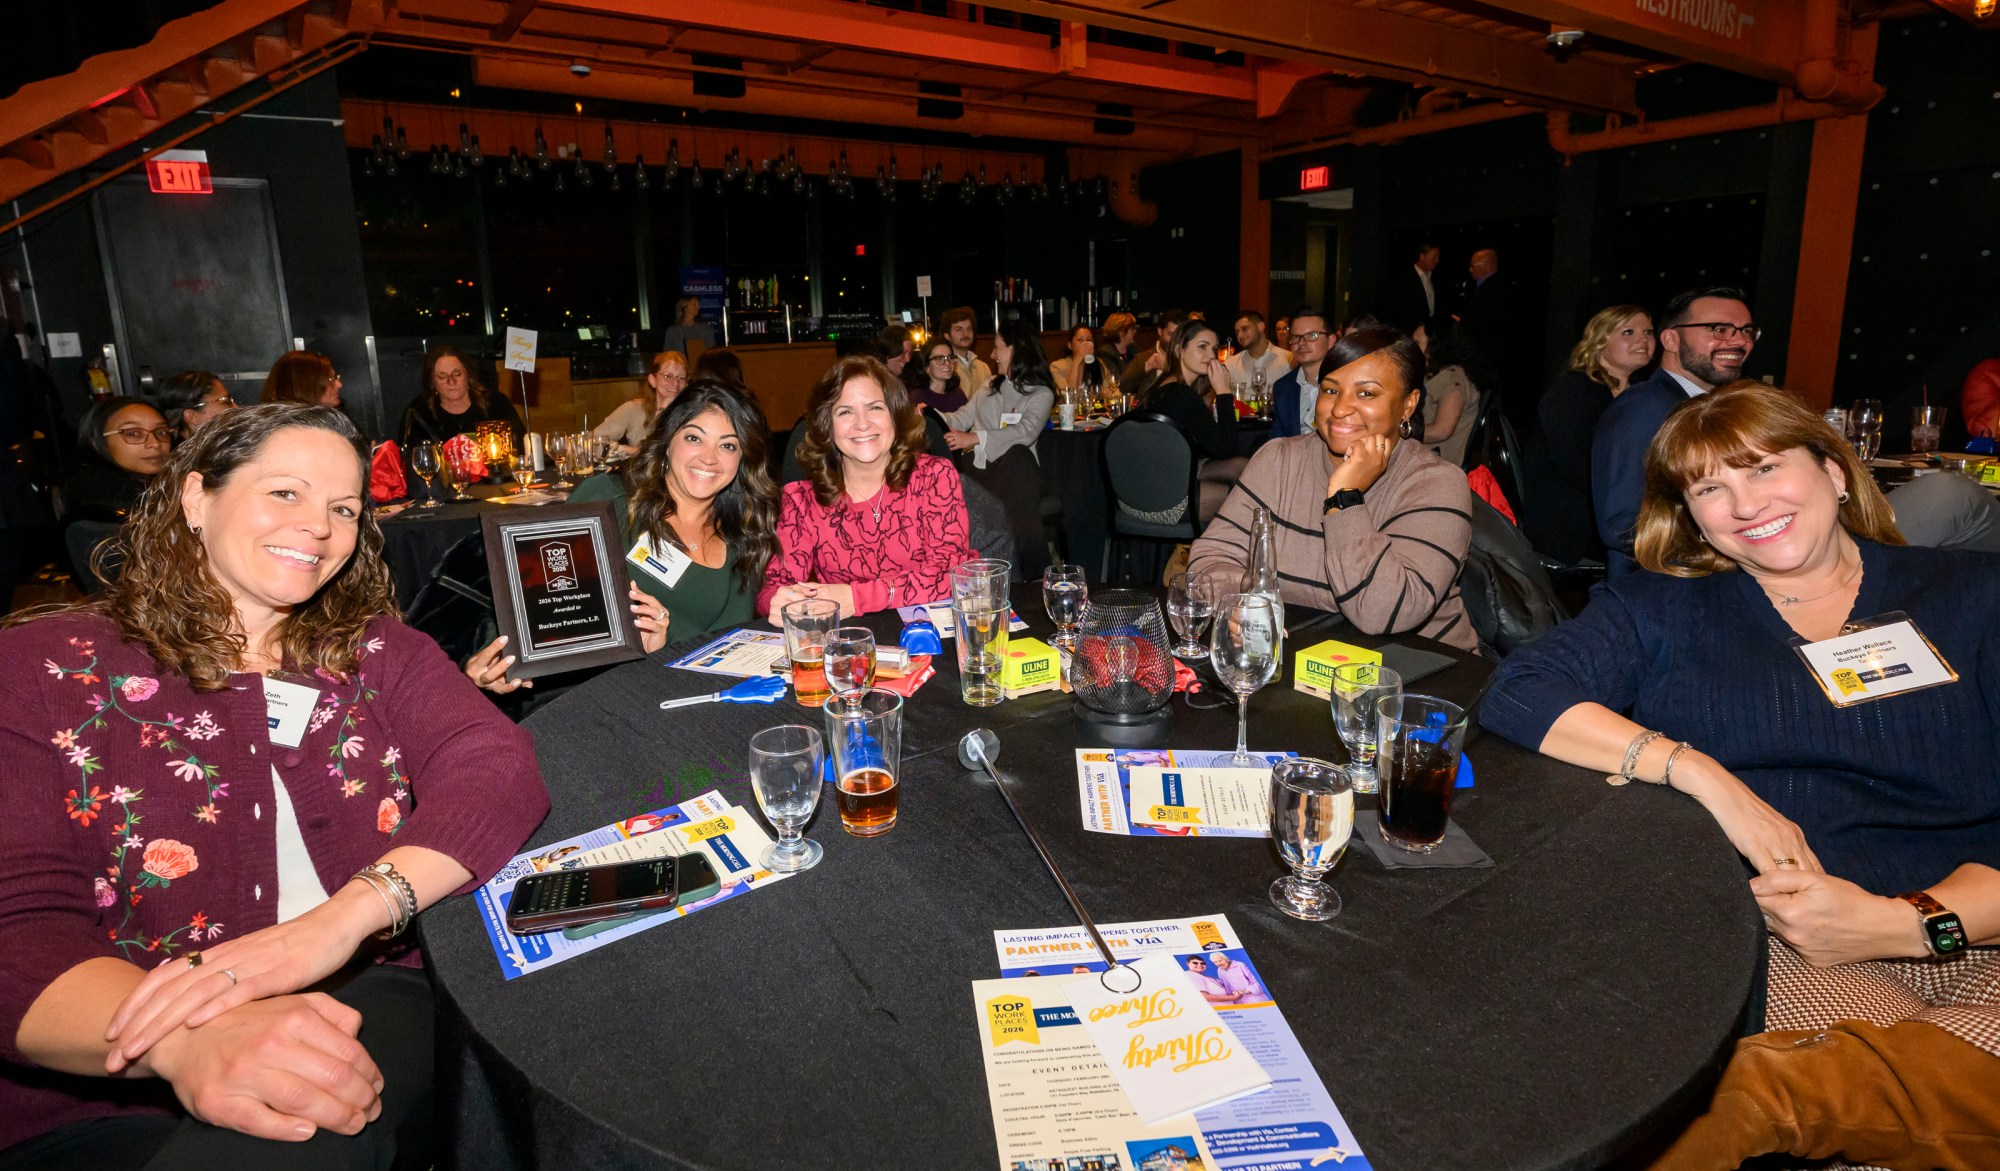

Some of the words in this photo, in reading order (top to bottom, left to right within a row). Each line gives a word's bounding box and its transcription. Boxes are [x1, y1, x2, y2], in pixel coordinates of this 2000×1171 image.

[1636, 0, 1736, 38] STROOMS
[157, 162, 202, 190] EXIT
[1306, 168, 1324, 187] EXIT
[546, 548, 566, 556] TOP
[538, 597, 551, 605] 2026
[563, 593, 591, 602] Workplace
[553, 605, 575, 613] Awarded
[538, 620, 562, 630] Buckeye
[563, 618, 588, 627] Partners,
[1832, 646, 1862, 657] Heather
[1862, 639, 1892, 650] Wallace
[1837, 653, 1867, 663] Buckeye
[1024, 660, 1048, 672] ULINE
[1308, 661, 1334, 676] ULINE
[1097, 784, 1108, 800] WITH
[693, 799, 714, 819] PART
[707, 794, 724, 811] LASTING
[1100, 802, 1113, 831] PARTNER
[1158, 808, 1166, 819] TOP
[714, 818, 729, 831] TOP
[1003, 934, 1044, 943] LASTING
[1046, 932, 1082, 941] IMPACT
[1084, 929, 1128, 938] HPPENS
[1129, 925, 1183, 934] TOGETHER.
[1005, 941, 1085, 956] PARTNER
[1087, 939, 1129, 950] WTH
[992, 1003, 1024, 1012] TOP
[1088, 988, 1184, 1029] Three
[995, 1017, 1027, 1025] PLACES
[1040, 1013, 1060, 1021] THE
[1122, 1026, 1232, 1074] Thirty
[1032, 1066, 1065, 1074] EVENT
[1072, 1063, 1108, 1071] DETAIL
[1216, 1136, 1259, 1147] Development
